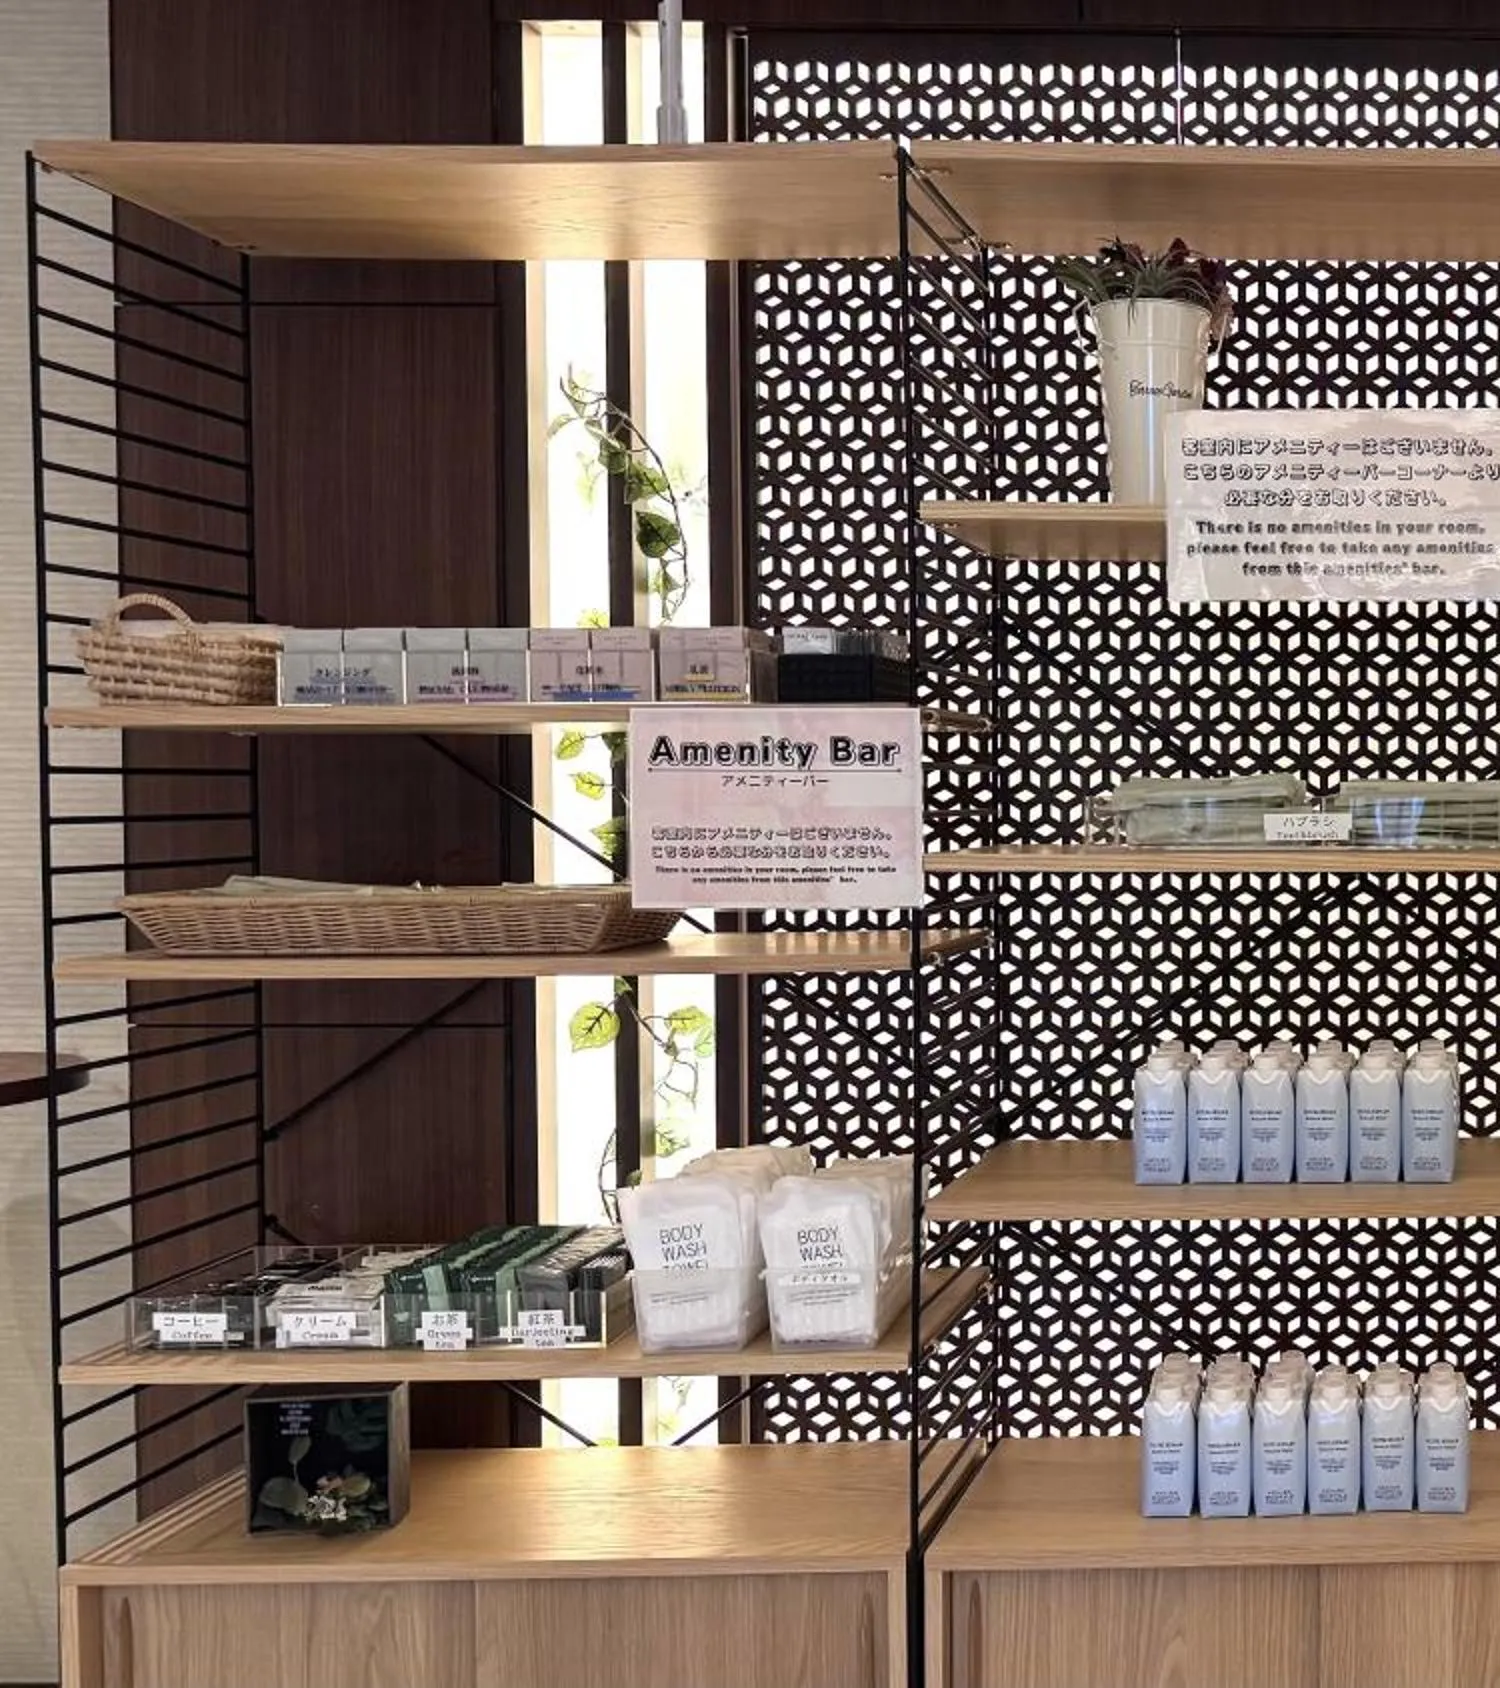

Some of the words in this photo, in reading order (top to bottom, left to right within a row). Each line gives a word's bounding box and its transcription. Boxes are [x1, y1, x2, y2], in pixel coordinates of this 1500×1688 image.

[1181, 437, 1493, 456] 客室内にアメニティーはございません。
[1183, 463, 1500, 481] こちらのアメニティーバーコーナーより
[1225, 487, 1447, 507] 必要な分をお取りください。
[1196, 521, 1244, 535] There
[1248, 521, 1263, 534] is
[1267, 523, 1287, 534] no
[1291, 520, 1371, 535] amenities
[1375, 520, 1392, 534] in
[1396, 522, 1435, 537] your
[1438, 522, 1486, 535] room.
[1187, 541, 1239, 557] please
[1244, 541, 1276, 554] feel
[1281, 541, 1315, 554] free
[1319, 541, 1337, 554] to
[1341, 541, 1378, 554] take
[1382, 543, 1411, 557] any
[1416, 541, 1495, 555] amenities
[1242, 561, 1283, 577] from
[1286, 561, 1320, 576] this
[1411, 560, 1447, 576] bar.
[650, 734, 819, 770] Amenity
[828, 734, 902, 767] Bar
[722, 774, 829, 788] アメニティーバー
[1282, 815, 1336, 827] ハブラシ
[659, 1223, 705, 1245] BODY
[797, 1225, 840, 1244] BODY
[661, 1242, 708, 1263] WASH
[799, 1243, 844, 1262] WASH
[163, 1316, 220, 1327] コーヒー
[294, 1316, 347, 1328] クリーム
[431, 1313, 459, 1326] お茶
[528, 1313, 555, 1326] 紅茶
[427, 1329, 462, 1339] Green
[435, 1340, 456, 1349] tea
[534, 1339, 555, 1348] tea
